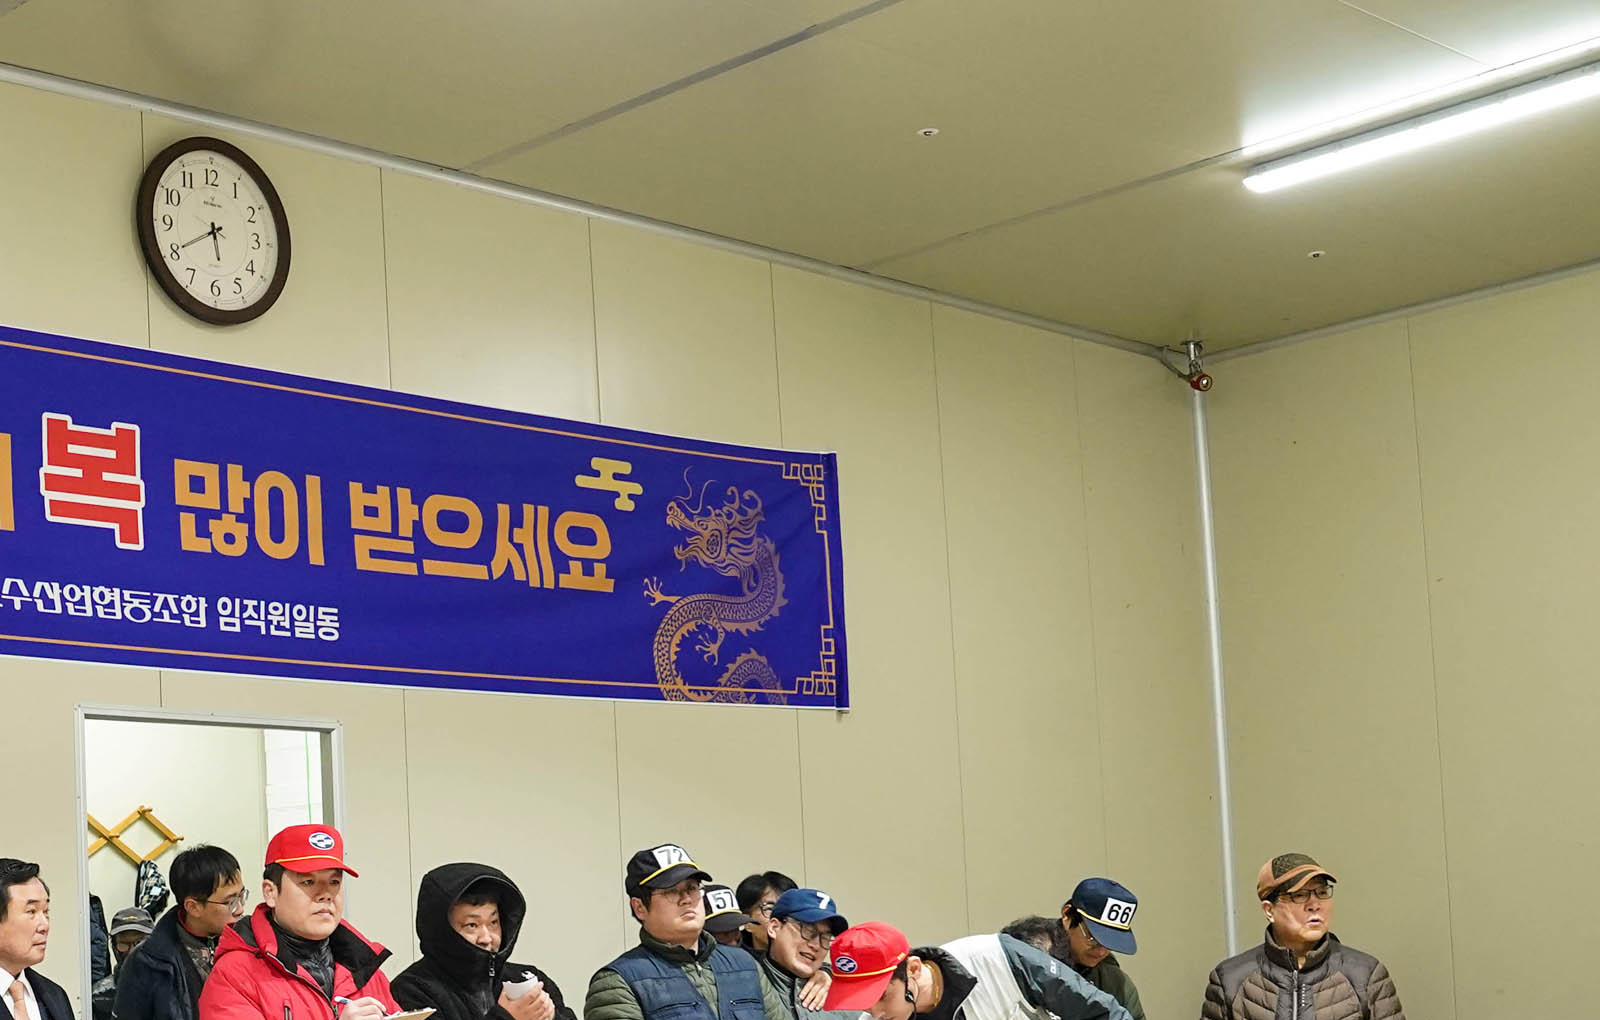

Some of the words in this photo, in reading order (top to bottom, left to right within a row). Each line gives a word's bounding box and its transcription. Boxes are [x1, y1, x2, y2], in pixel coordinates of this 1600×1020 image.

[181, 170, 193, 188] 11
[204, 168, 219, 187] 12
[165, 187, 181, 206] 10
[232, 182, 238, 200] 1
[162, 214, 173, 231] 9
[247, 206, 256, 223] 2
[251, 233, 261, 250] 3
[170, 243, 180, 261] 8
[185, 268, 196, 285] 7
[245, 260, 256, 276] 4
[210, 279, 221, 297] 6
[233, 277, 243, 294] 5
[39, 412, 145, 550] 복
[174, 458, 325, 565] 많이
[349, 481, 615, 593] 받으세요
[217, 596, 340, 641] 임직원일동
[712, 891, 734, 909] 57
[1108, 904, 1131, 924] 66
